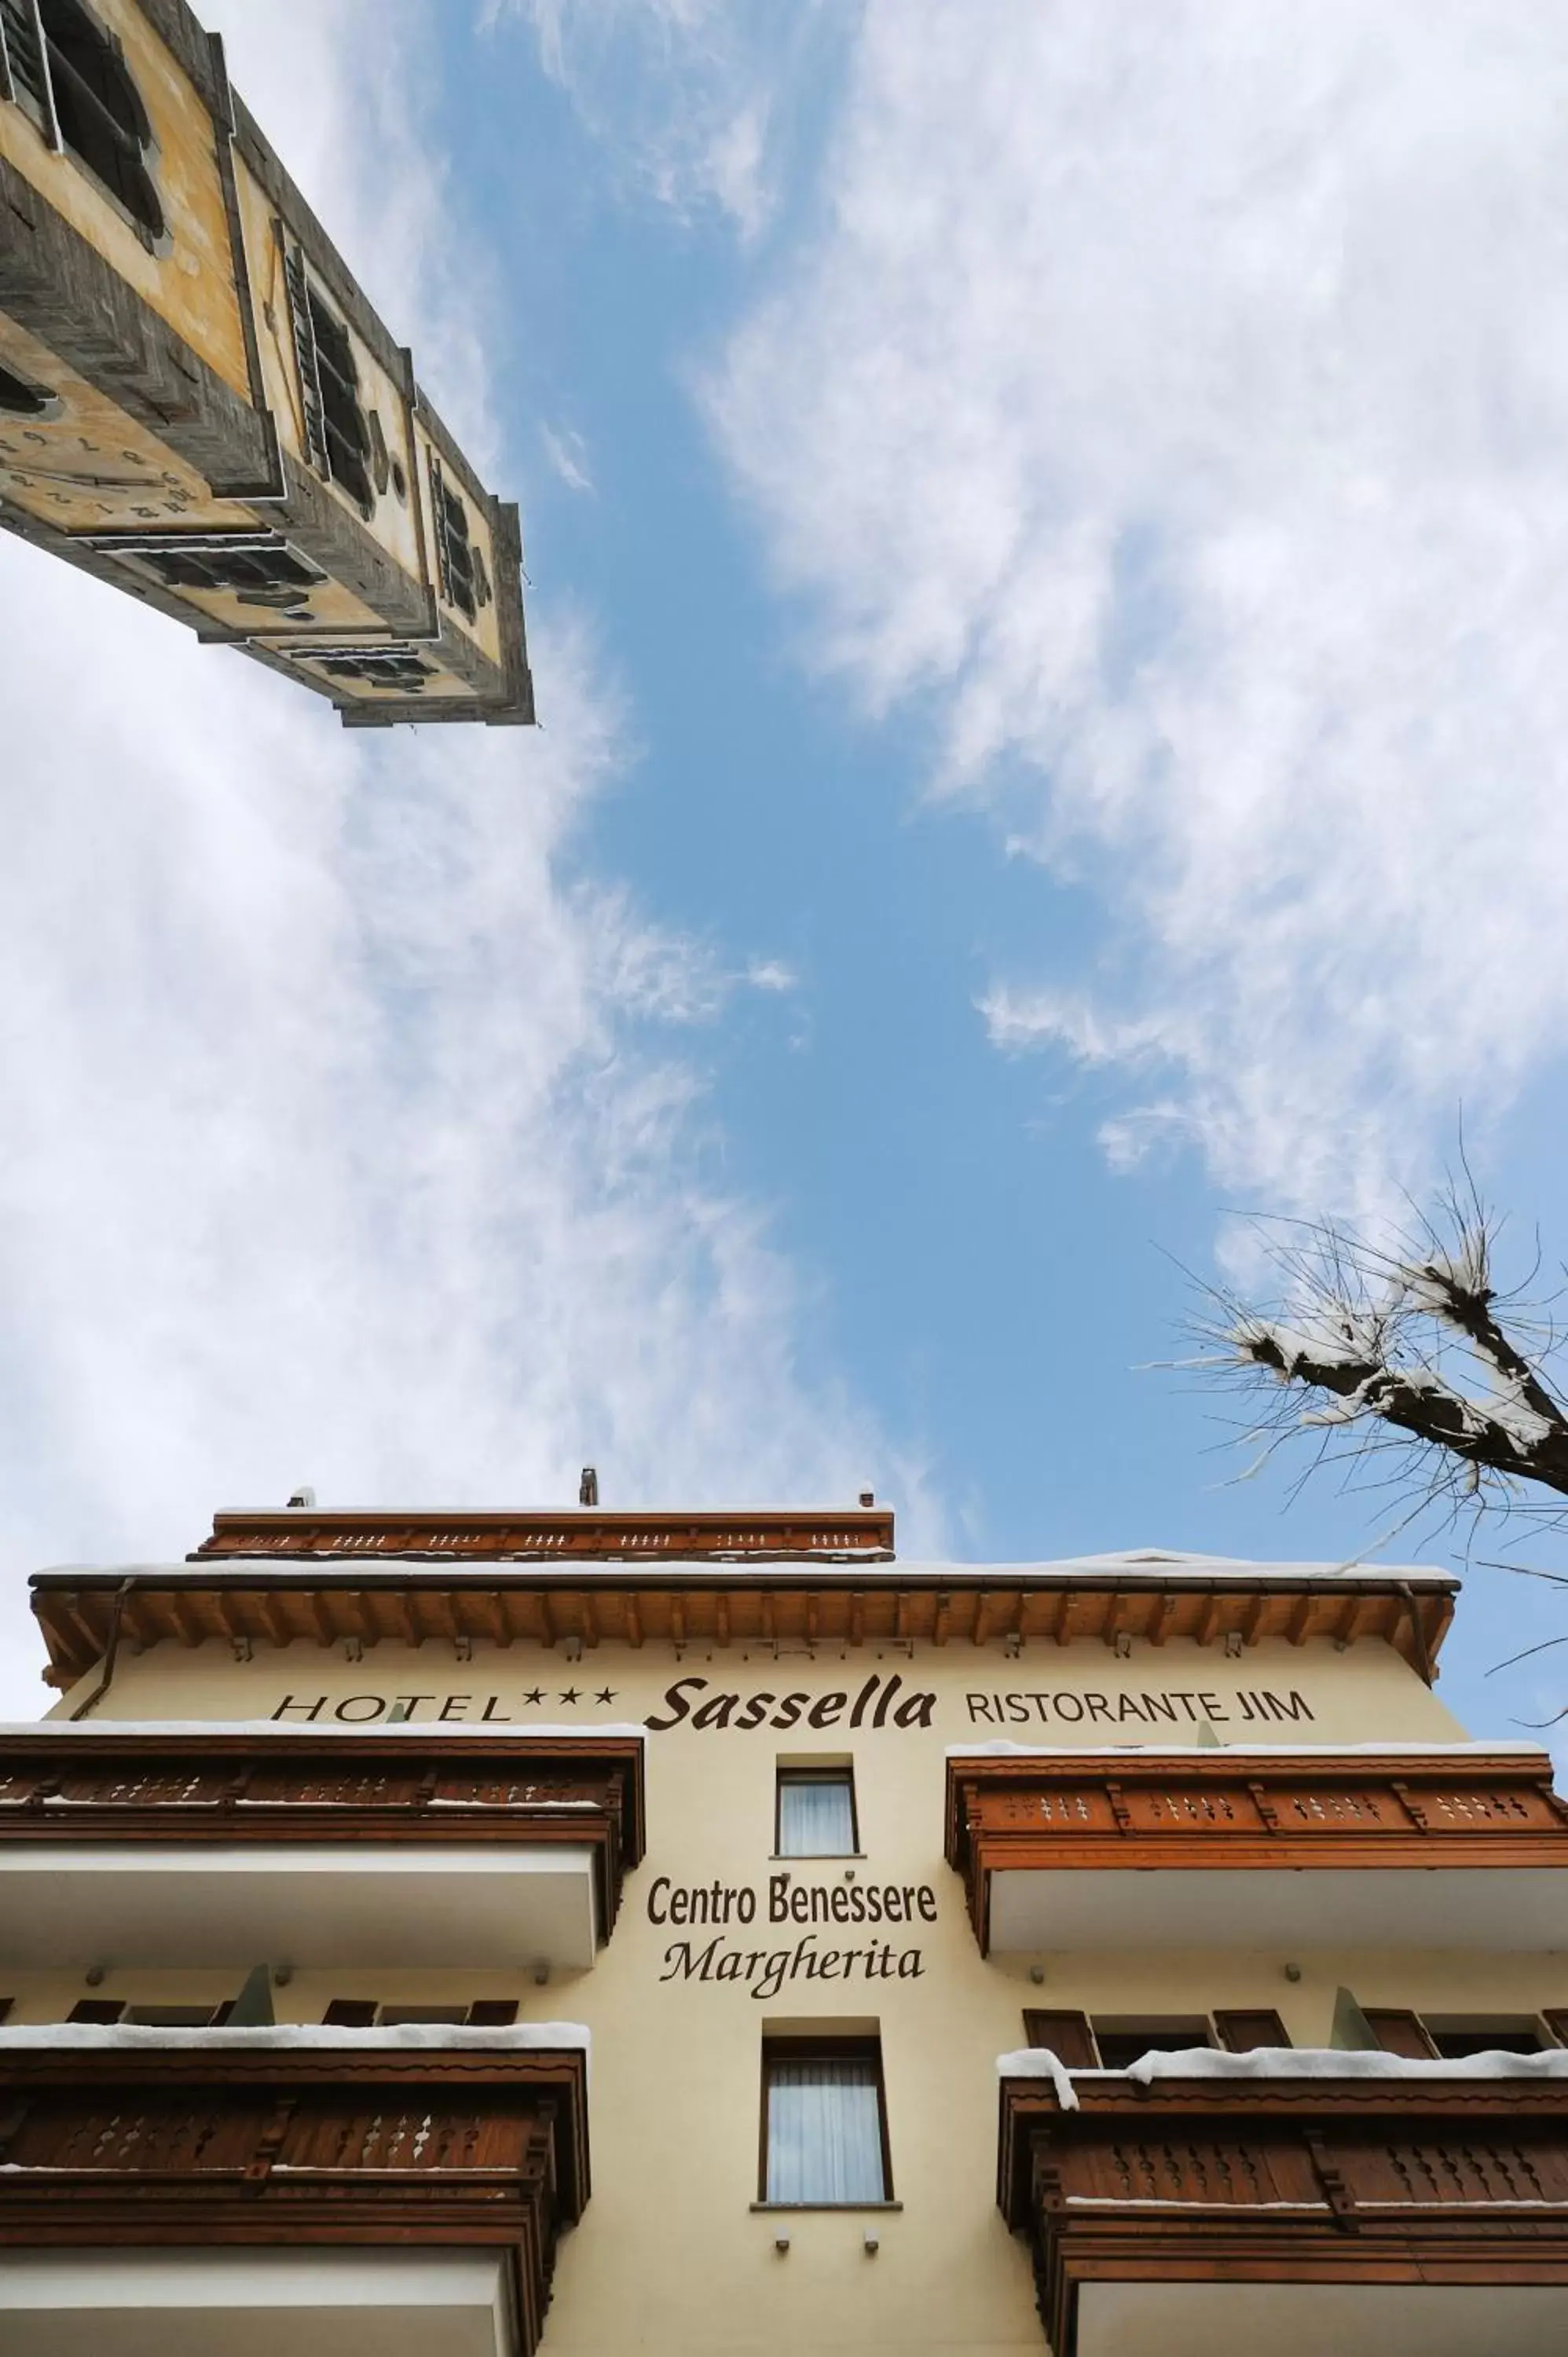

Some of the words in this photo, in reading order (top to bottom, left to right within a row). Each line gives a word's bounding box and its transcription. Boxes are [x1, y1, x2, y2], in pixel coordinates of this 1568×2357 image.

[78, 437, 101, 451] 7
[270, 1695, 511, 1723] HOTEL
[643, 1673, 938, 1731] Sassella
[965, 1692, 1230, 1723] RISTORANTE
[1236, 1691, 1316, 1721] JIM
[647, 1876, 757, 1926] Centro
[769, 1875, 938, 1924] Benessere
[658, 1934, 926, 2000] Margherita
